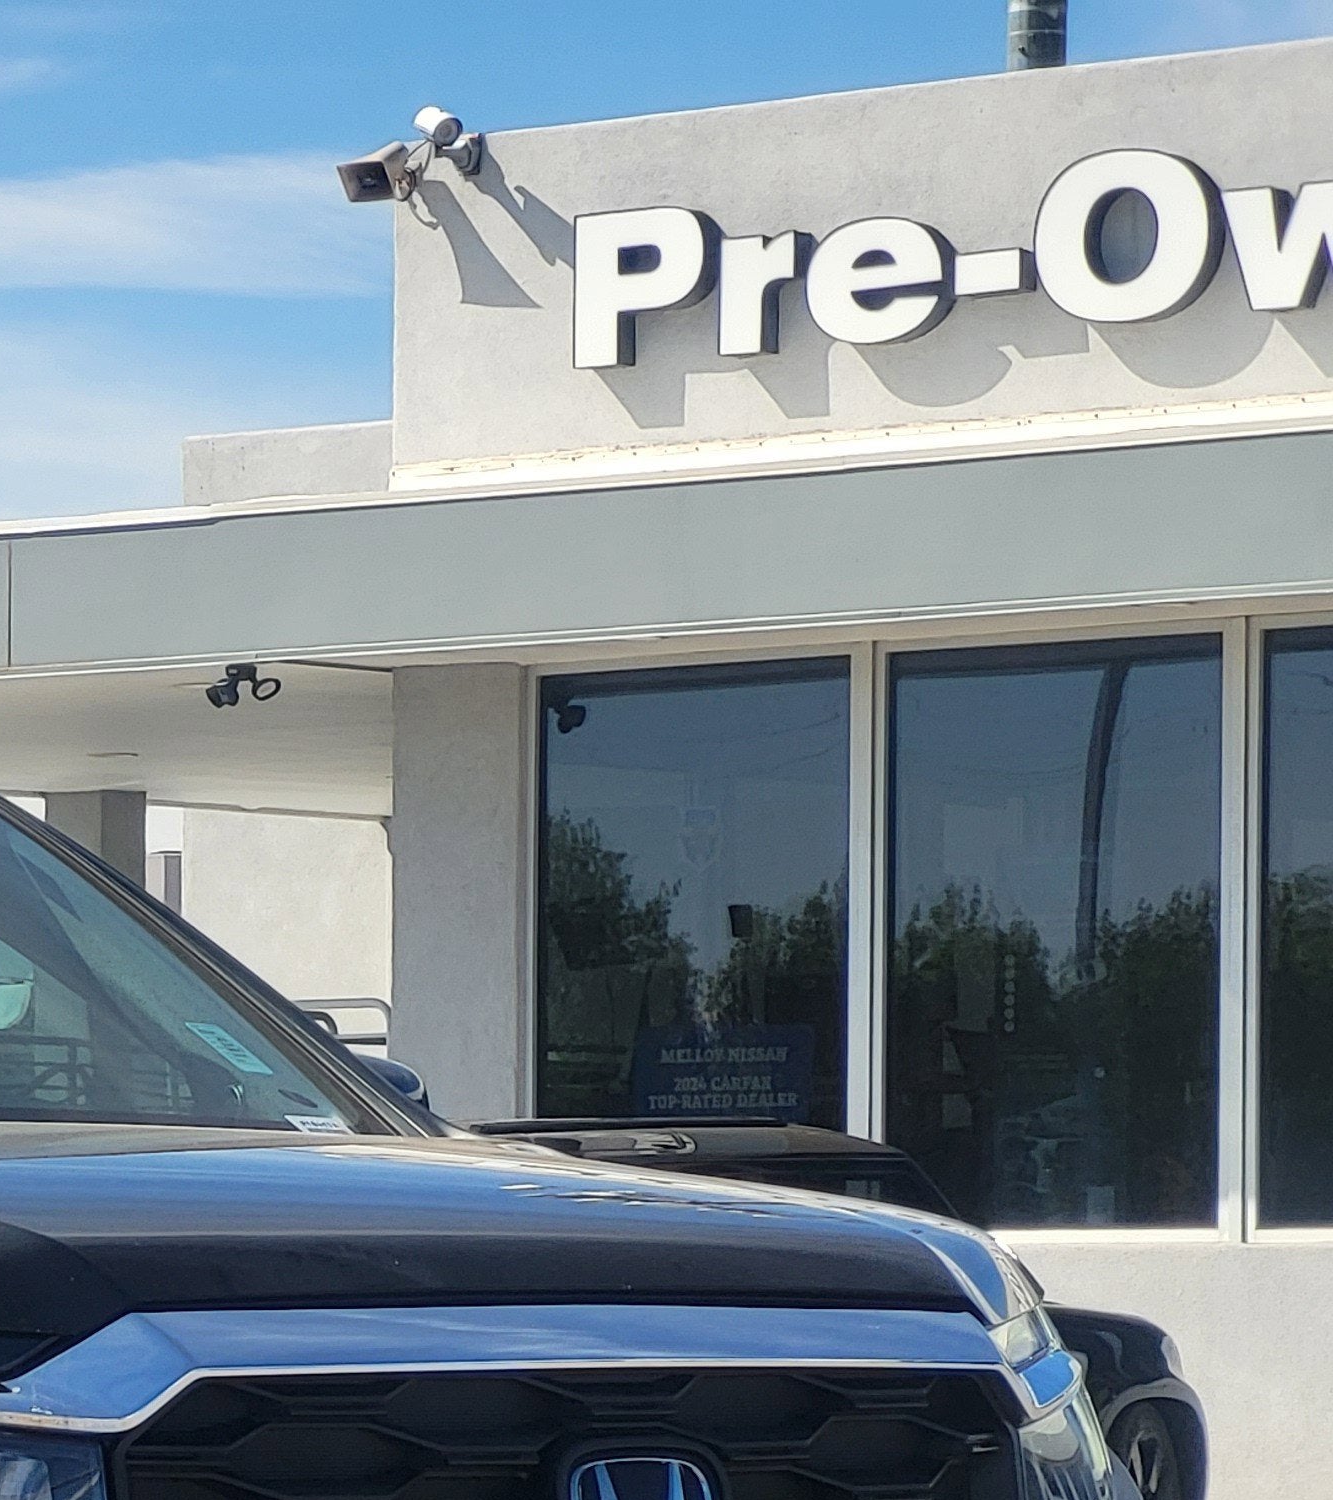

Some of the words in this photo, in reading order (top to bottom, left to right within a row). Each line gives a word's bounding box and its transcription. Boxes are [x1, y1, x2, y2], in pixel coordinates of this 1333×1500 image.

[727, 1046, 788, 1062] NISSAN
[710, 1075, 772, 1091] CARFAX
[648, 1094, 733, 1110] TOP-RATED
[736, 1092, 798, 1108] DEALER
